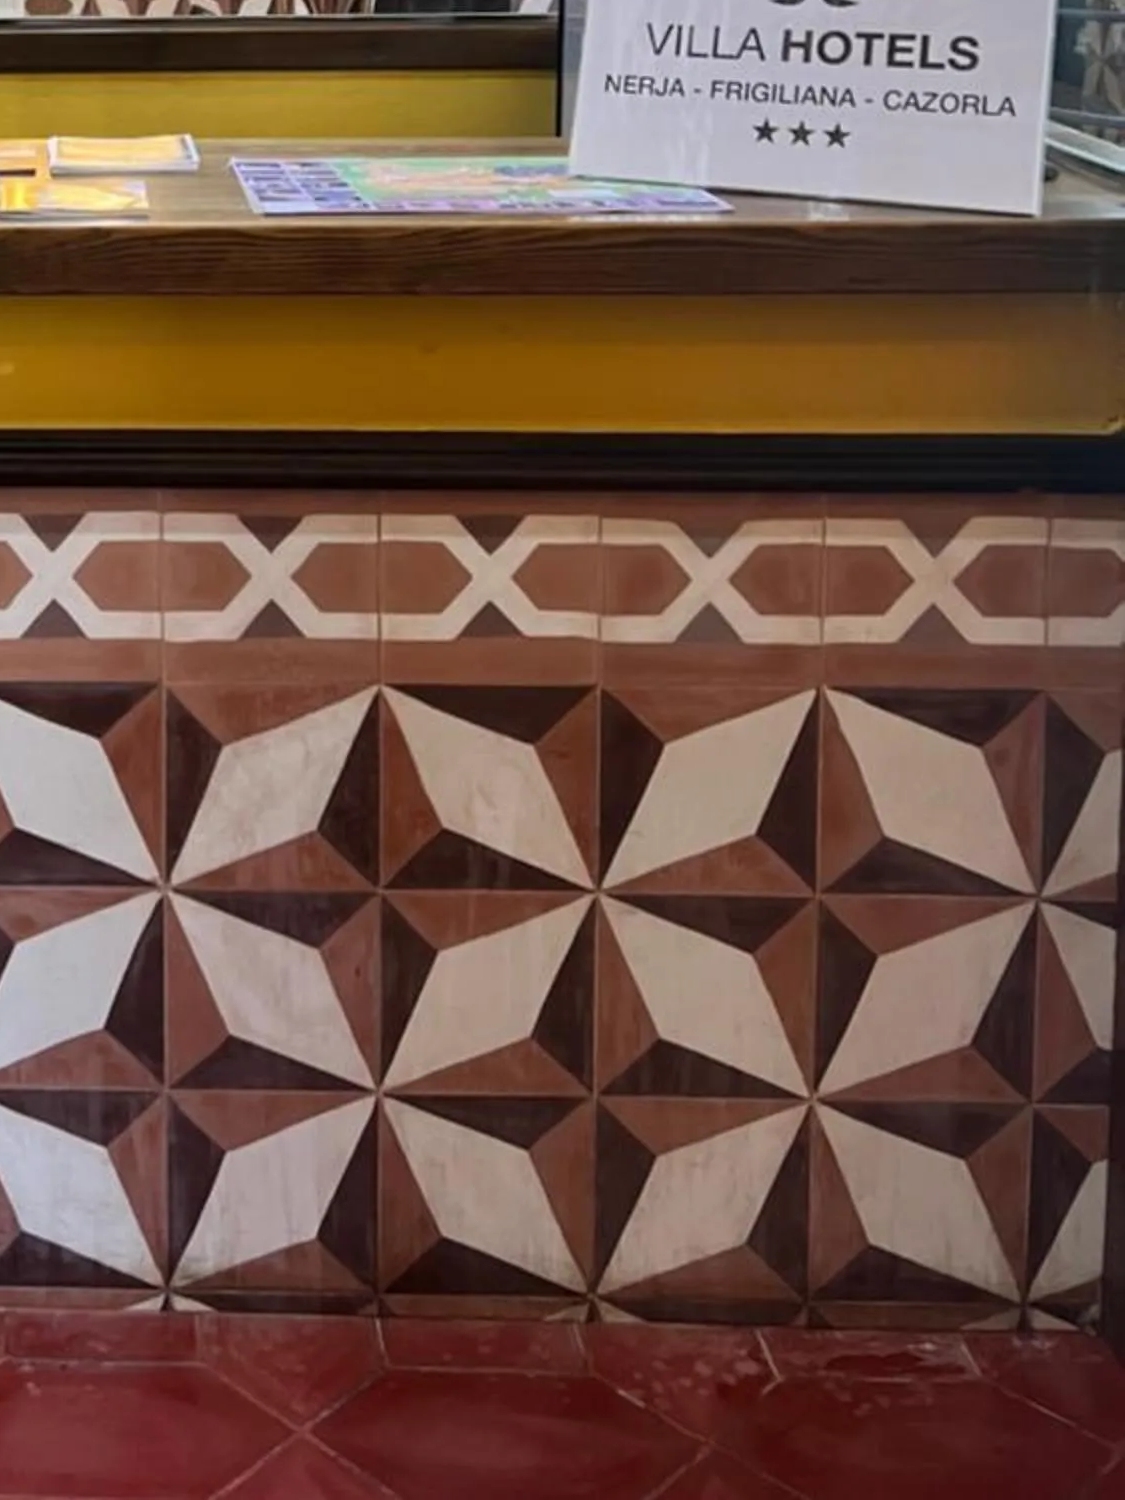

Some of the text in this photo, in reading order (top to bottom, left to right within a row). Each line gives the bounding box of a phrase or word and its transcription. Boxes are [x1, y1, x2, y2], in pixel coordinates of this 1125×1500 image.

[646, 22, 980, 71] VILLA HOTELS
[604, 74, 685, 98] NERJA
[709, 79, 856, 108] FRIGILIANA
[882, 89, 1017, 117] CAZORLA
